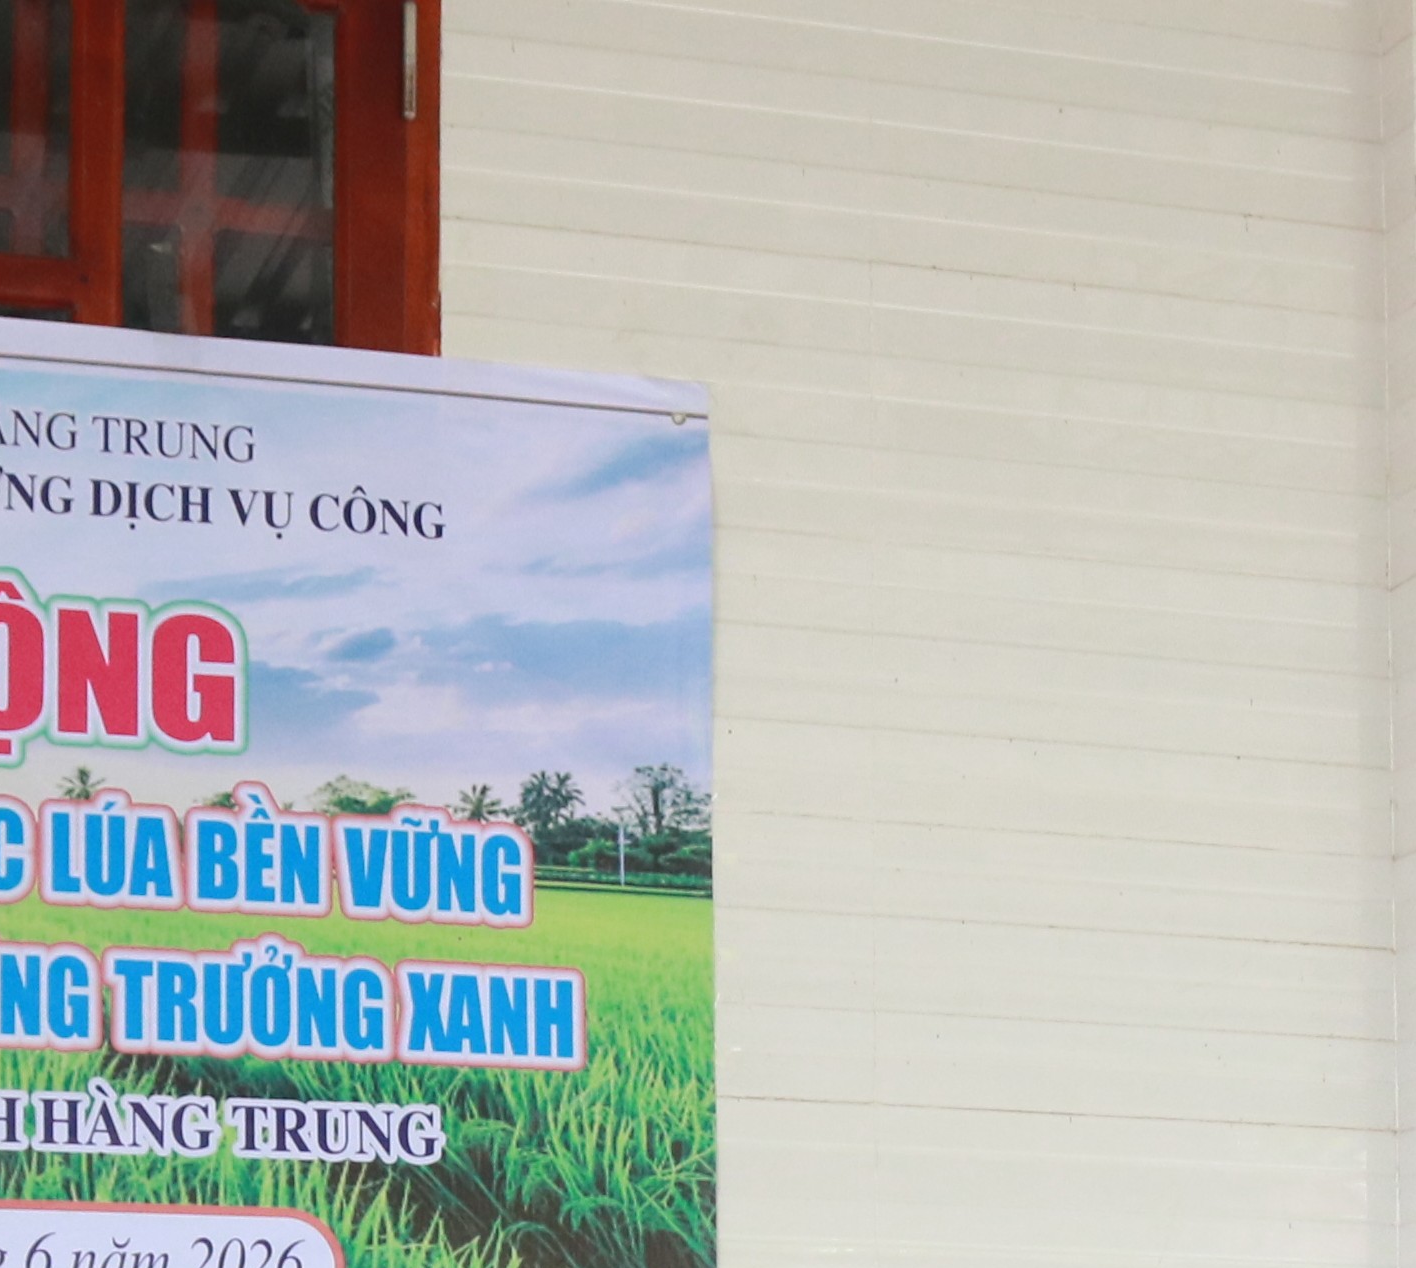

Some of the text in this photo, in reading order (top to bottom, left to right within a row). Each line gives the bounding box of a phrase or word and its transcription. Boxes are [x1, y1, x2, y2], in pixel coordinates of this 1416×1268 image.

[92, 415, 257, 464] TRUNG
[89, 478, 213, 530] DỊCH
[229, 488, 294, 540] VỤ
[308, 485, 447, 540] CÔNG
[50, 801, 174, 899] LÚA
[195, 790, 322, 906] BỀN
[342, 816, 523, 916] VỮNG
[113, 943, 386, 1051] TRƯỞNG
[406, 970, 574, 1059] XANH
[40, 1084, 212, 1150] HÀNG
[234, 1106, 440, 1158] TRUNG
